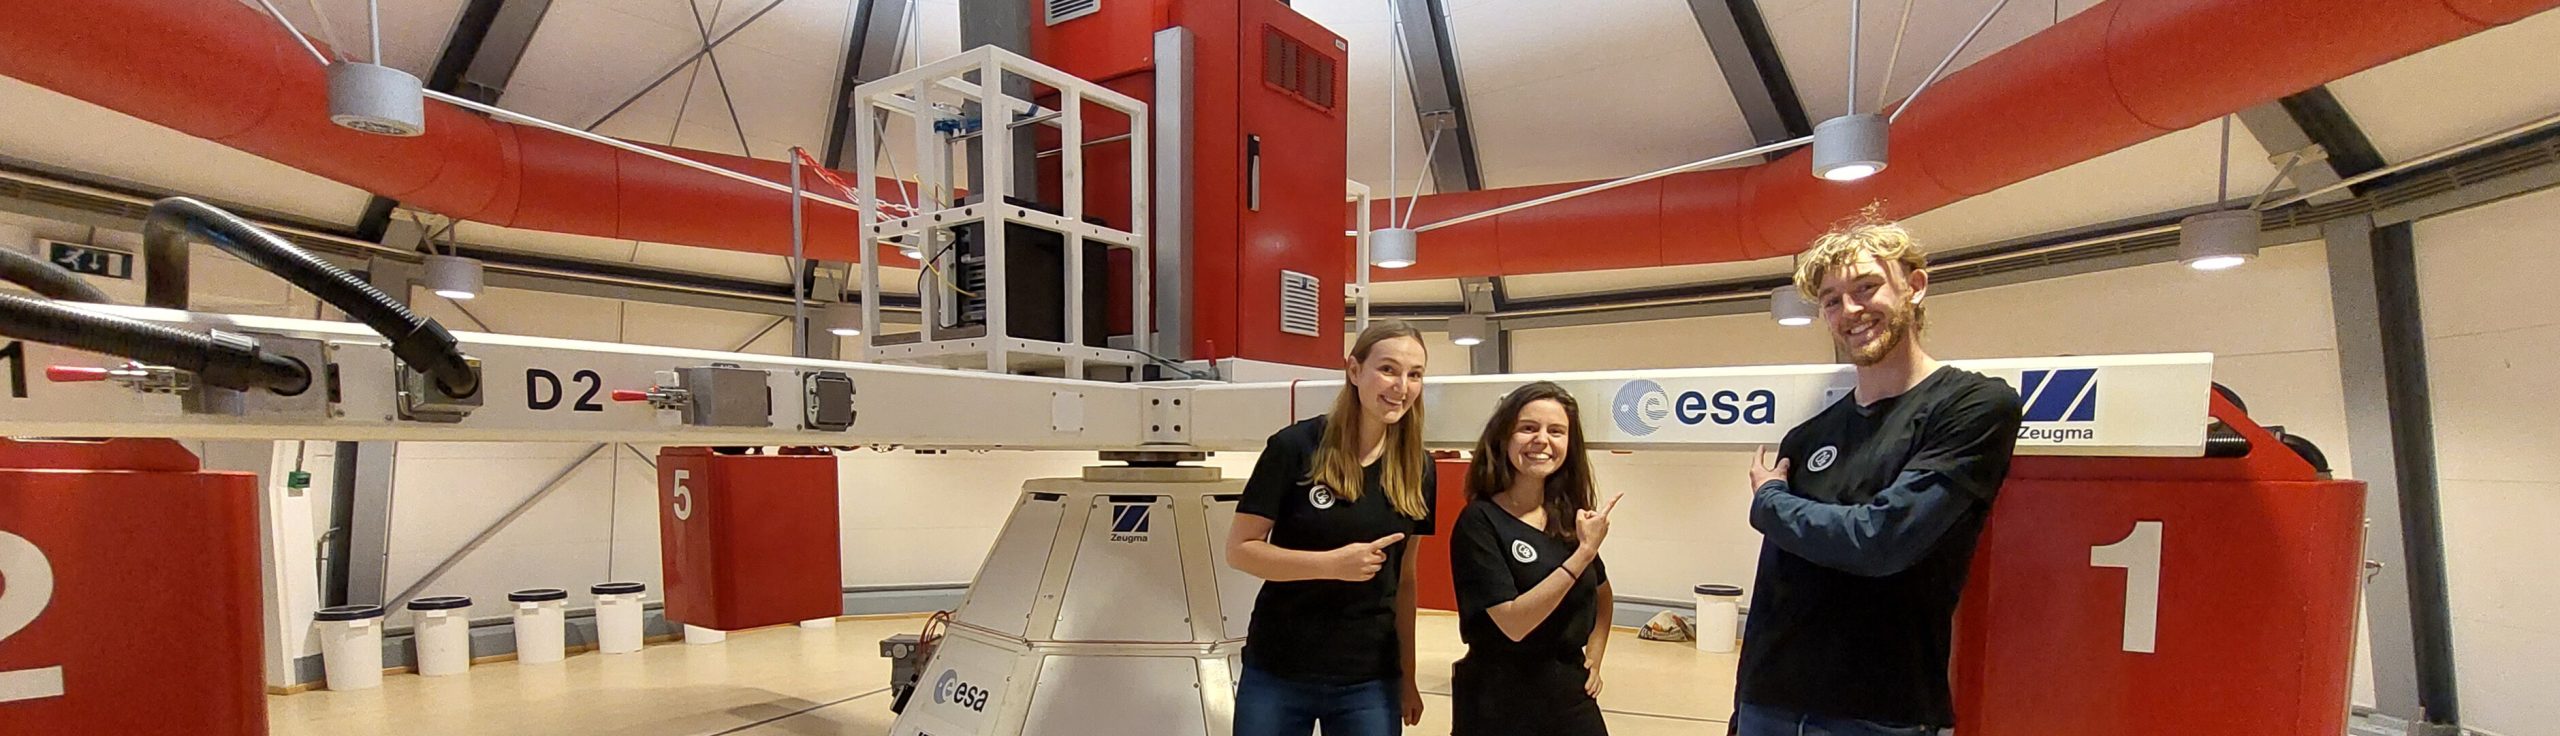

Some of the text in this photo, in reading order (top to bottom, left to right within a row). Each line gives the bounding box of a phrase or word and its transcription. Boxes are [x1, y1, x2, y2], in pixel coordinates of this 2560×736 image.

[526, 368, 603, 412] D2
[1676, 389, 1776, 425] esa
[2017, 425, 2094, 443] Zeugma
[673, 469, 692, 520] 5
[1110, 533, 1148, 543] Zeugma
[2090, 521, 2163, 654] 1
[953, 682, 989, 713] esa
